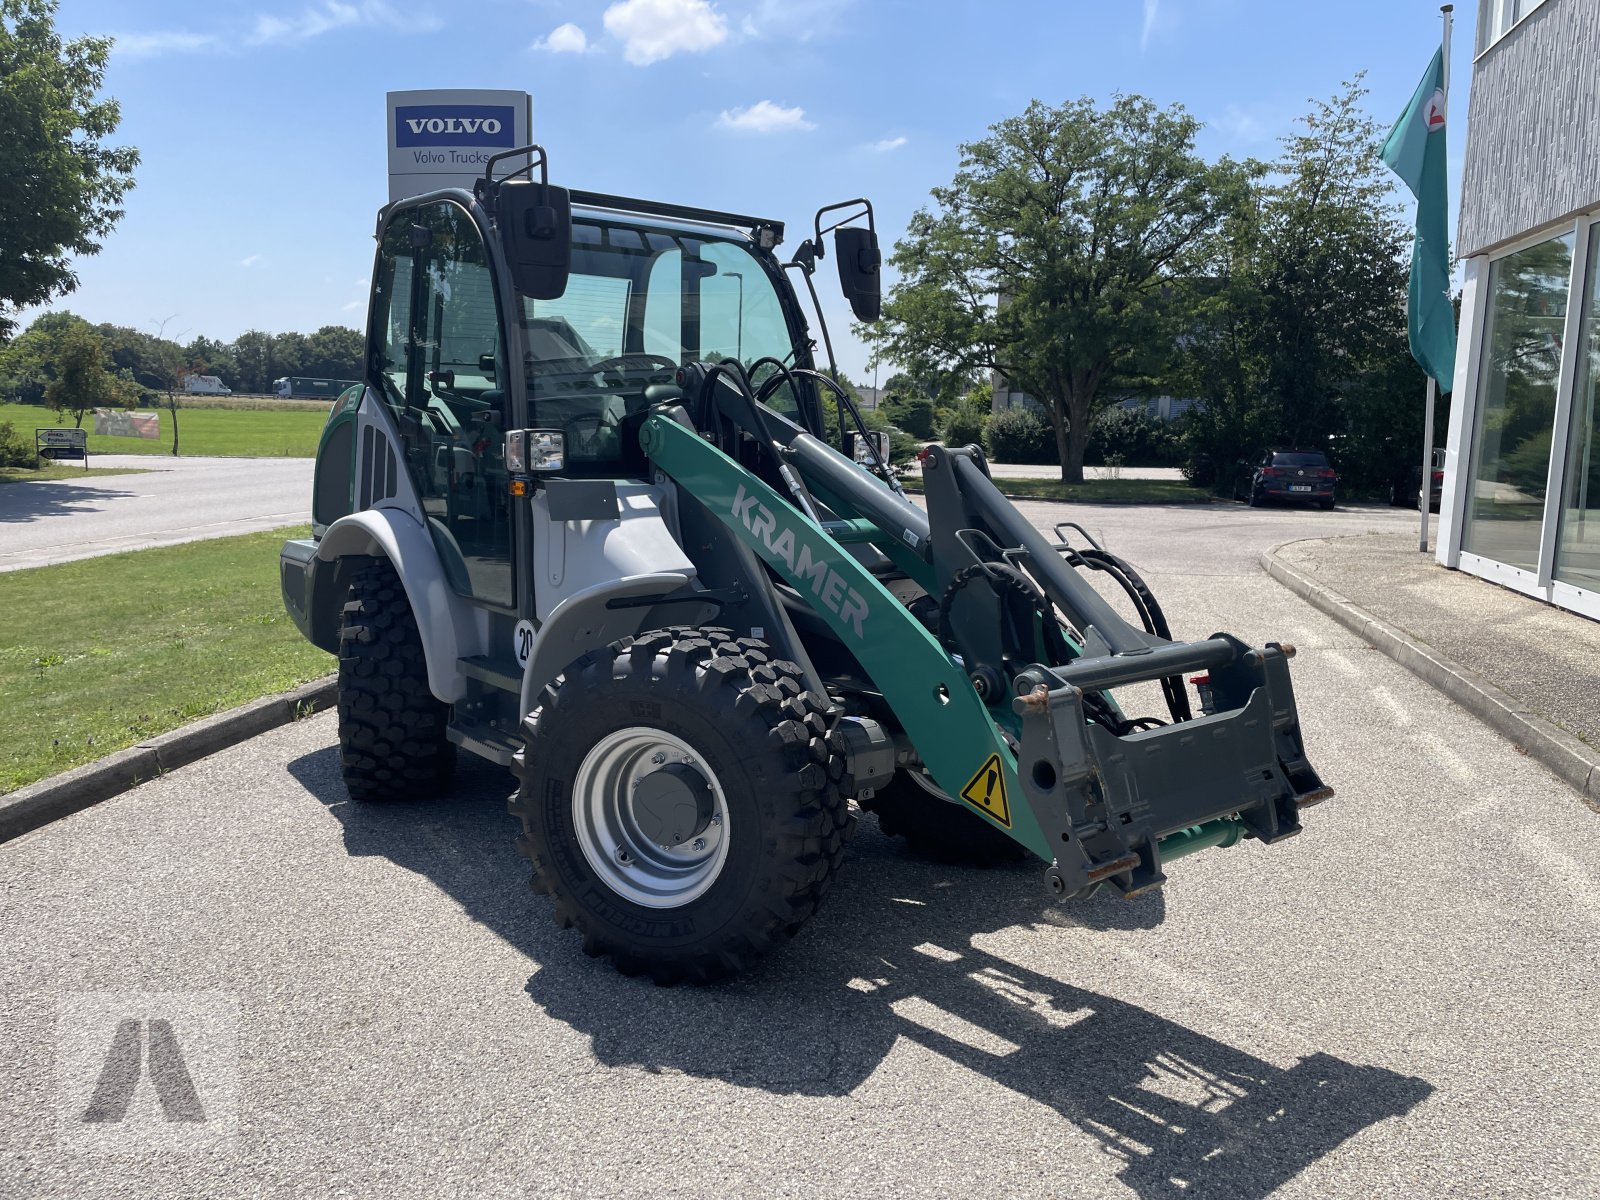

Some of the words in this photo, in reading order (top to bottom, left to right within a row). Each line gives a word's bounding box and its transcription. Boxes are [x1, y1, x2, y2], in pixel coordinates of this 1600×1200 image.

[406, 118, 501, 134] VOLVO
[414, 151, 445, 164] Volvo
[449, 150, 490, 164] Trucks
[731, 483, 870, 640] KRAMER
[519, 627, 533, 662] 20
